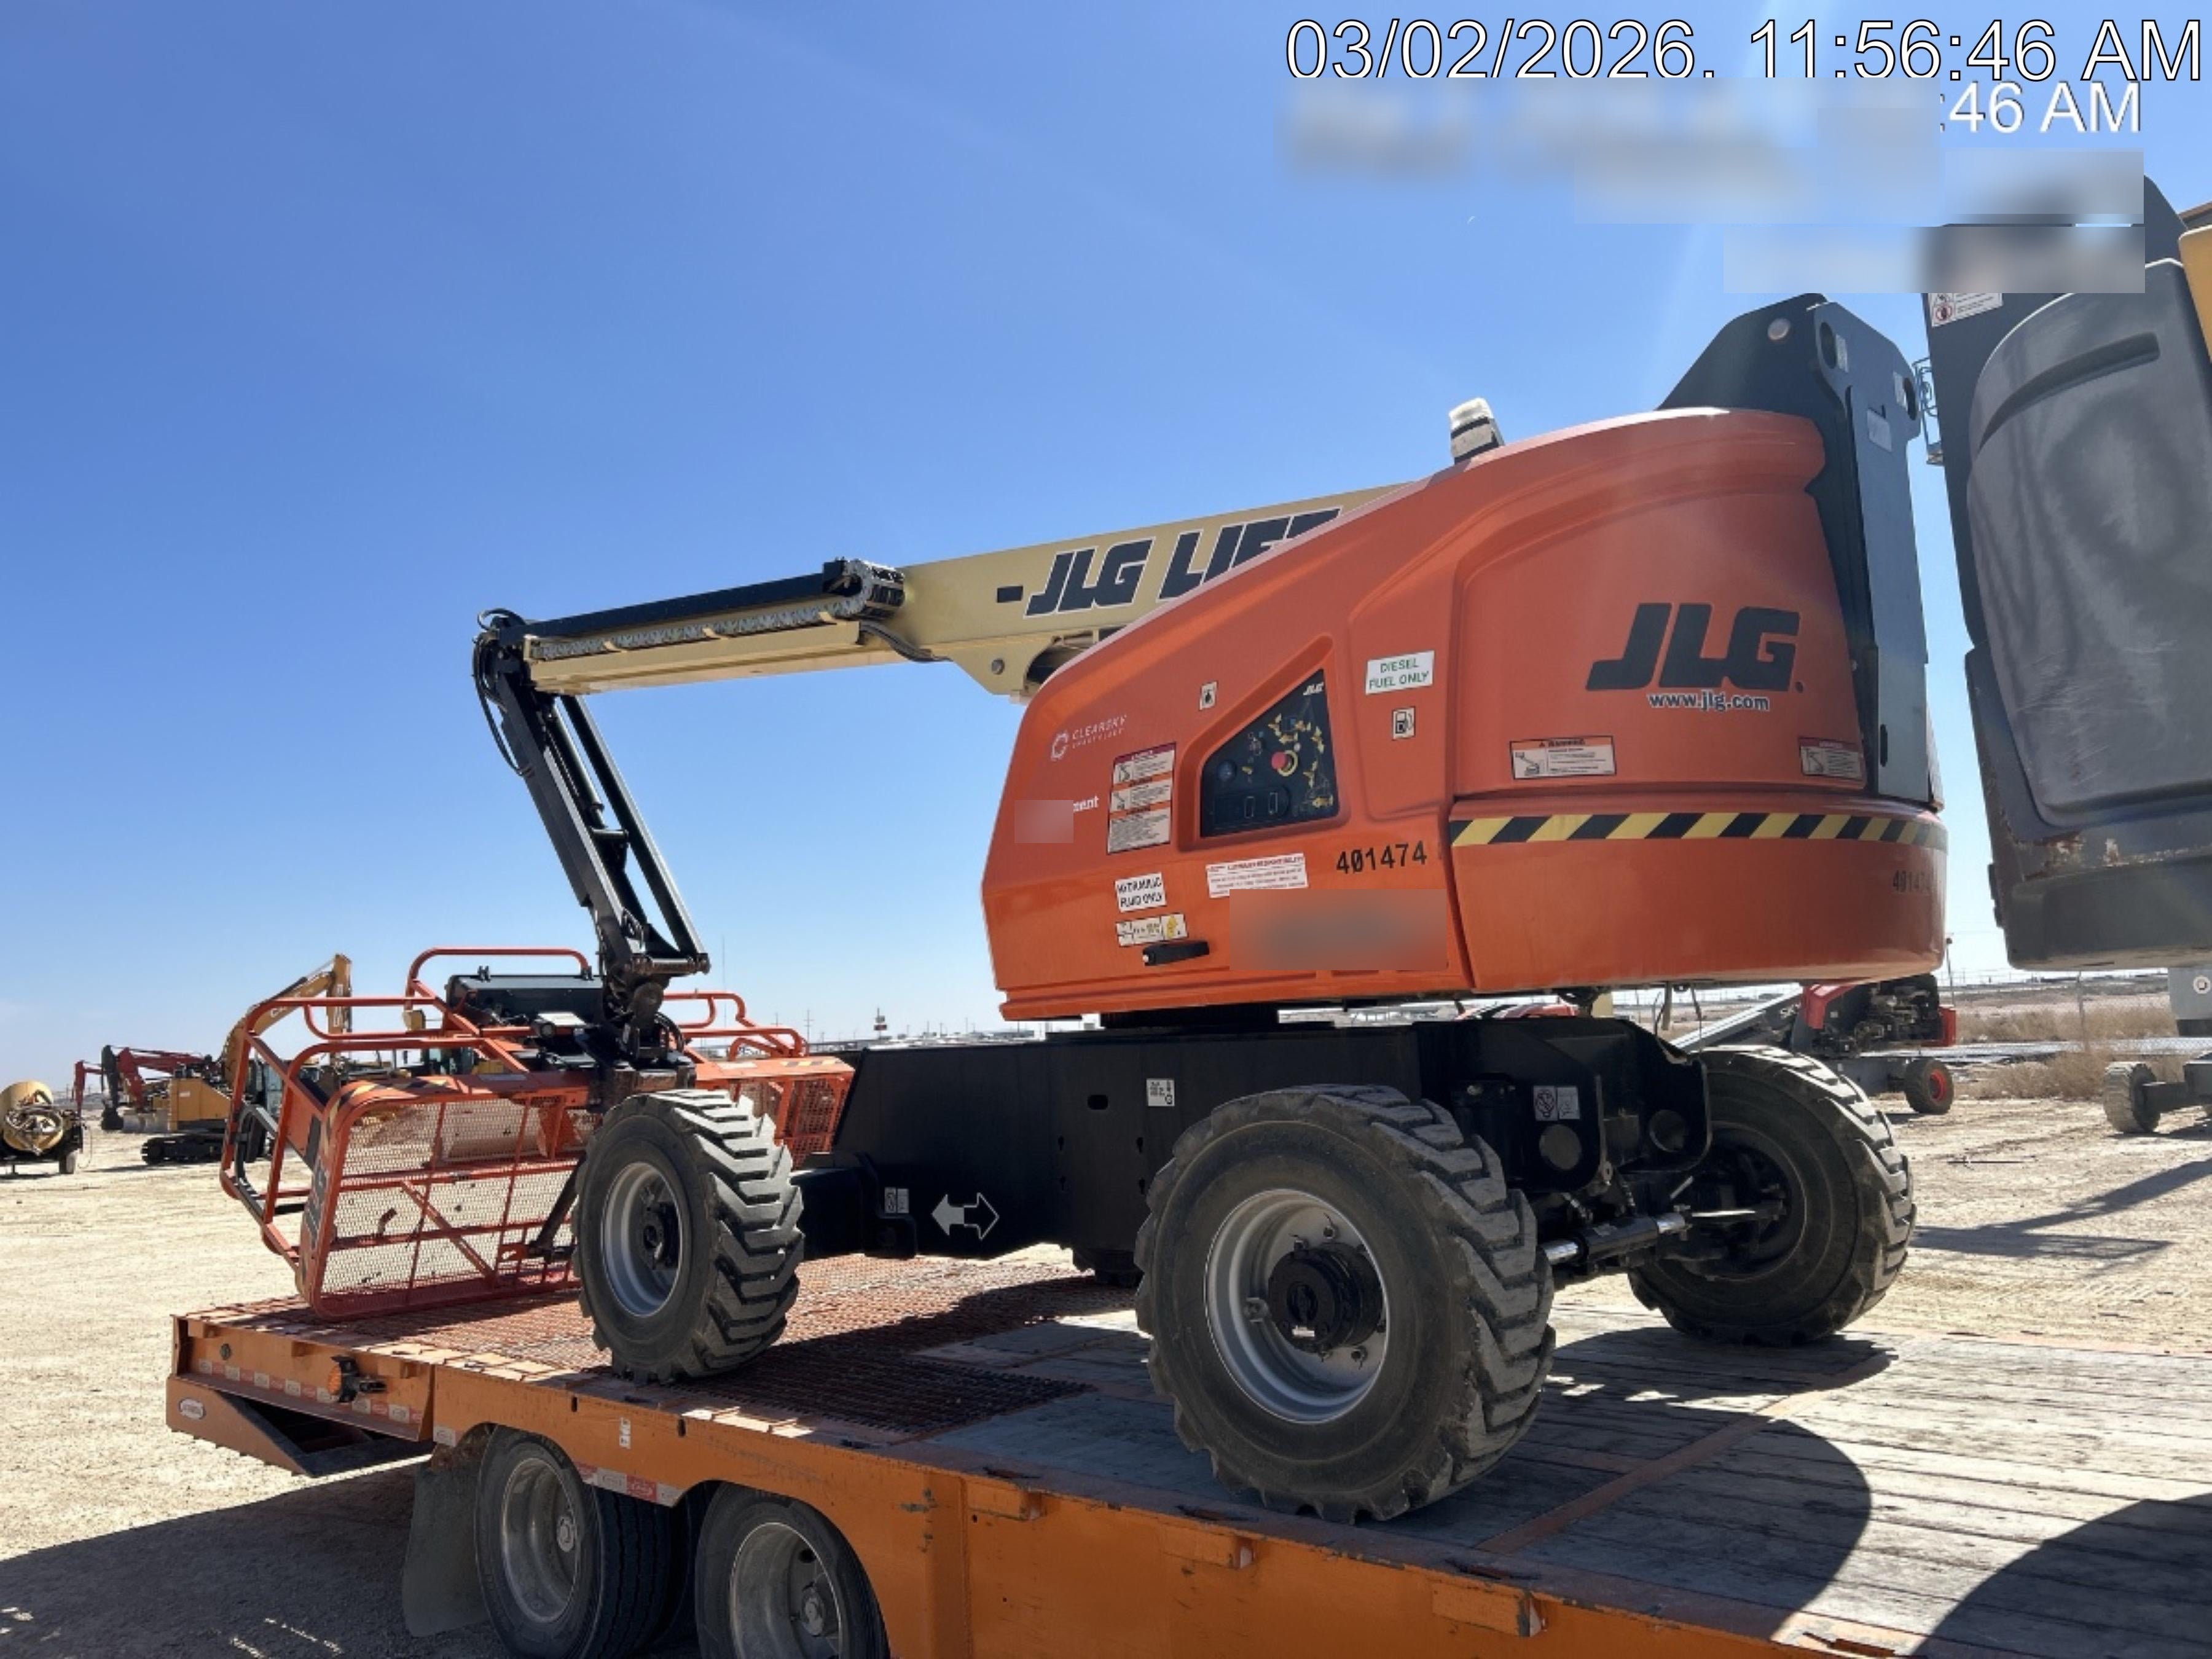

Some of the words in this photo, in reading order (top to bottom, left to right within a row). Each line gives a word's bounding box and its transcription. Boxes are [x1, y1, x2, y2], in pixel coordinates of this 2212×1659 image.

[1023, 538, 1156, 618] JLG
[1585, 602, 1802, 692] JLG
[1380, 658, 1419, 673] DIESEL
[1369, 677, 1396, 690] FUEL
[1398, 670, 1429, 684] ONLY
[1647, 689, 1770, 712] www.jlg.com
[1336, 840, 1427, 874] 401474
